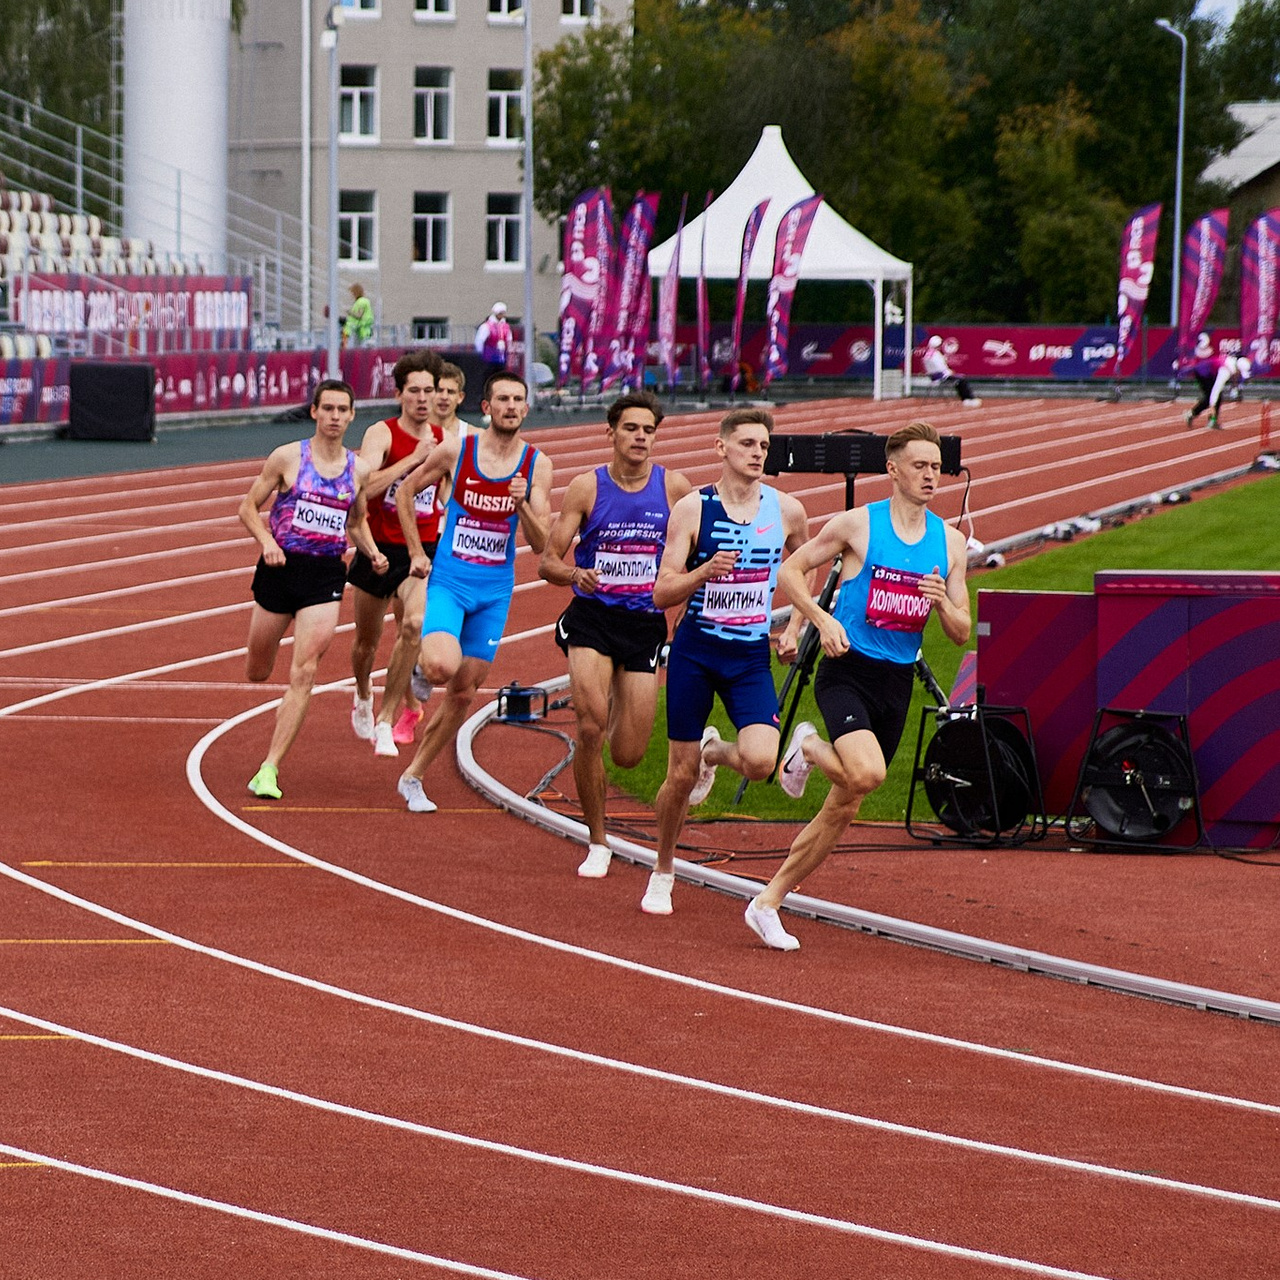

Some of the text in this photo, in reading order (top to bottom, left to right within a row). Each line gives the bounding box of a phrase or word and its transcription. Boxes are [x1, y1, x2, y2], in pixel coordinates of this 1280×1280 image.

[463, 489, 516, 512] RUSSIA
[296, 507, 343, 531] КОЧНЕВ
[456, 533, 507, 553] ЛОМАКИН
[706, 590, 756, 610] НИКИТИН
[869, 588, 931, 618] ХОЛМОГОРОВ
